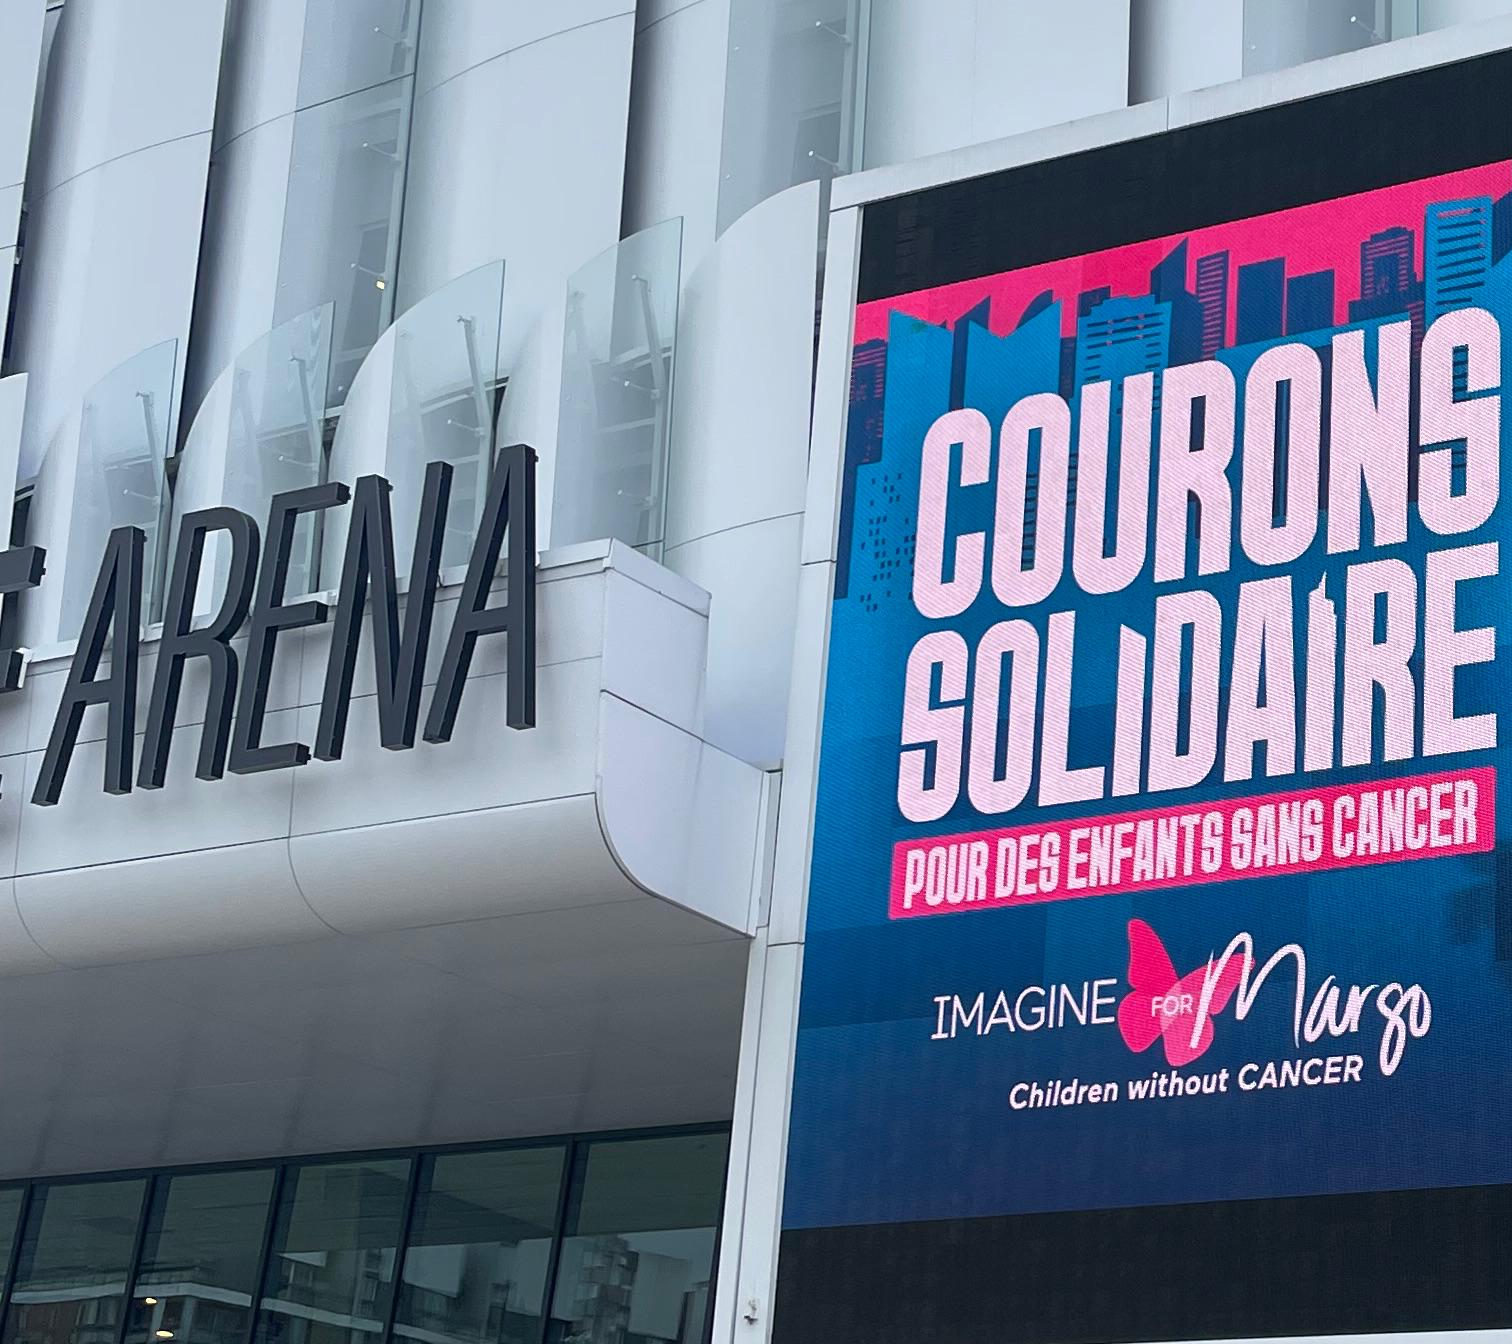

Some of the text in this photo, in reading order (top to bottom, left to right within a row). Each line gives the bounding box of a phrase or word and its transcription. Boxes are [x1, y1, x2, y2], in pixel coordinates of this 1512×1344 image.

[911, 307, 1501, 620] COURONS
[31, 443, 539, 806] ARENA
[902, 779, 1479, 910] POUR DES ENFANTS SANS CANCER
[931, 931, 1432, 1076] IMAGINE FOR Margo
[1009, 1055, 1365, 1110] Children without CANCER
